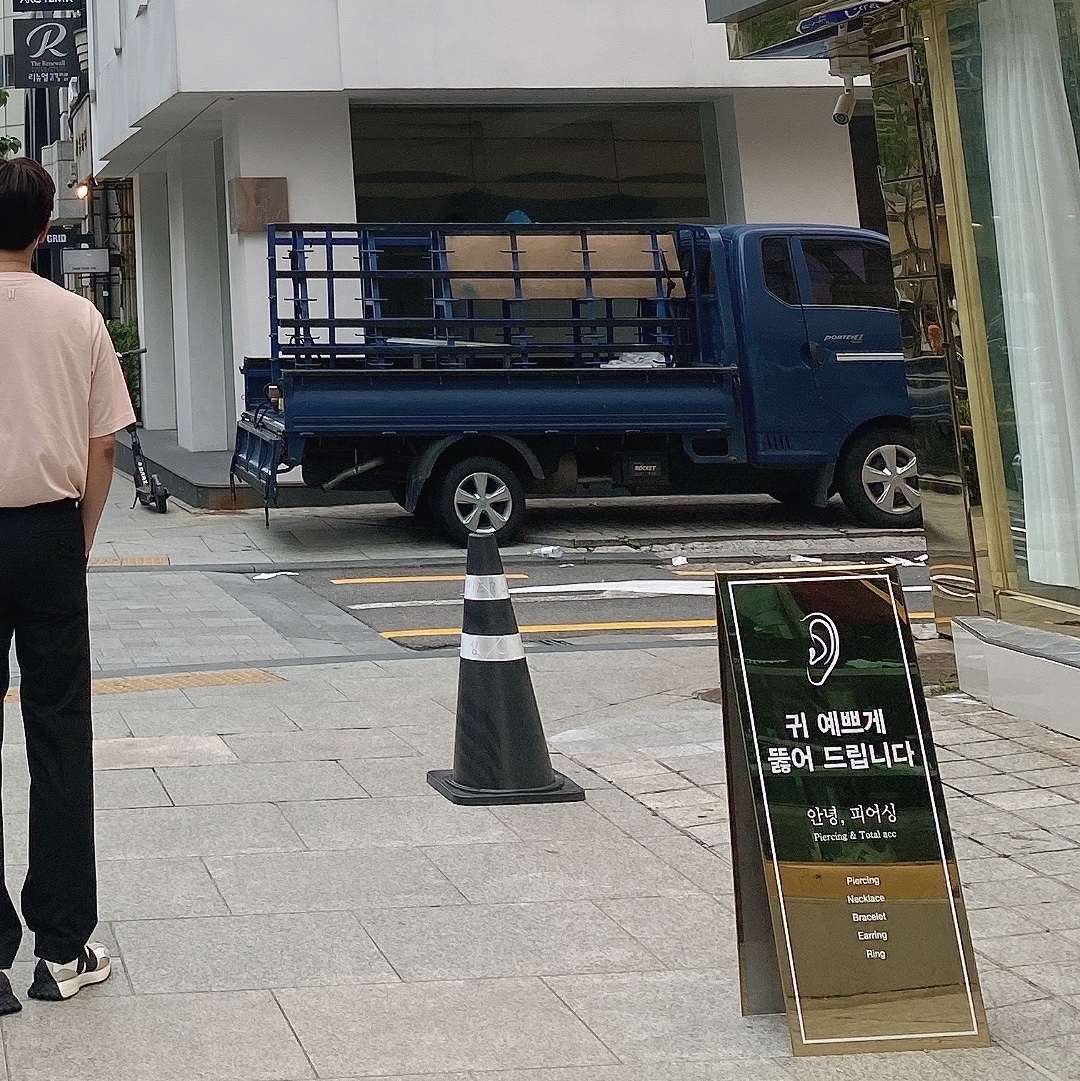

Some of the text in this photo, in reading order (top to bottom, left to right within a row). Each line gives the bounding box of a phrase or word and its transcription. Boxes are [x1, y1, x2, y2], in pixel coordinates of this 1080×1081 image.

[46, 234, 67, 243] GRID
[785, 708, 887, 739] 귀 예쁘게
[767, 740, 916, 774] 뚫어 드립니다
[807, 802, 897, 827] 안녕, 피어싱
[813, 830, 897, 842] Piercing & Total acc
[846, 876, 880, 886] Piercing
[847, 894, 886, 904] Necklace
[852, 912, 887, 922] Bracelet
[857, 930, 888, 941] Earring
[865, 949, 886, 960] Ring
